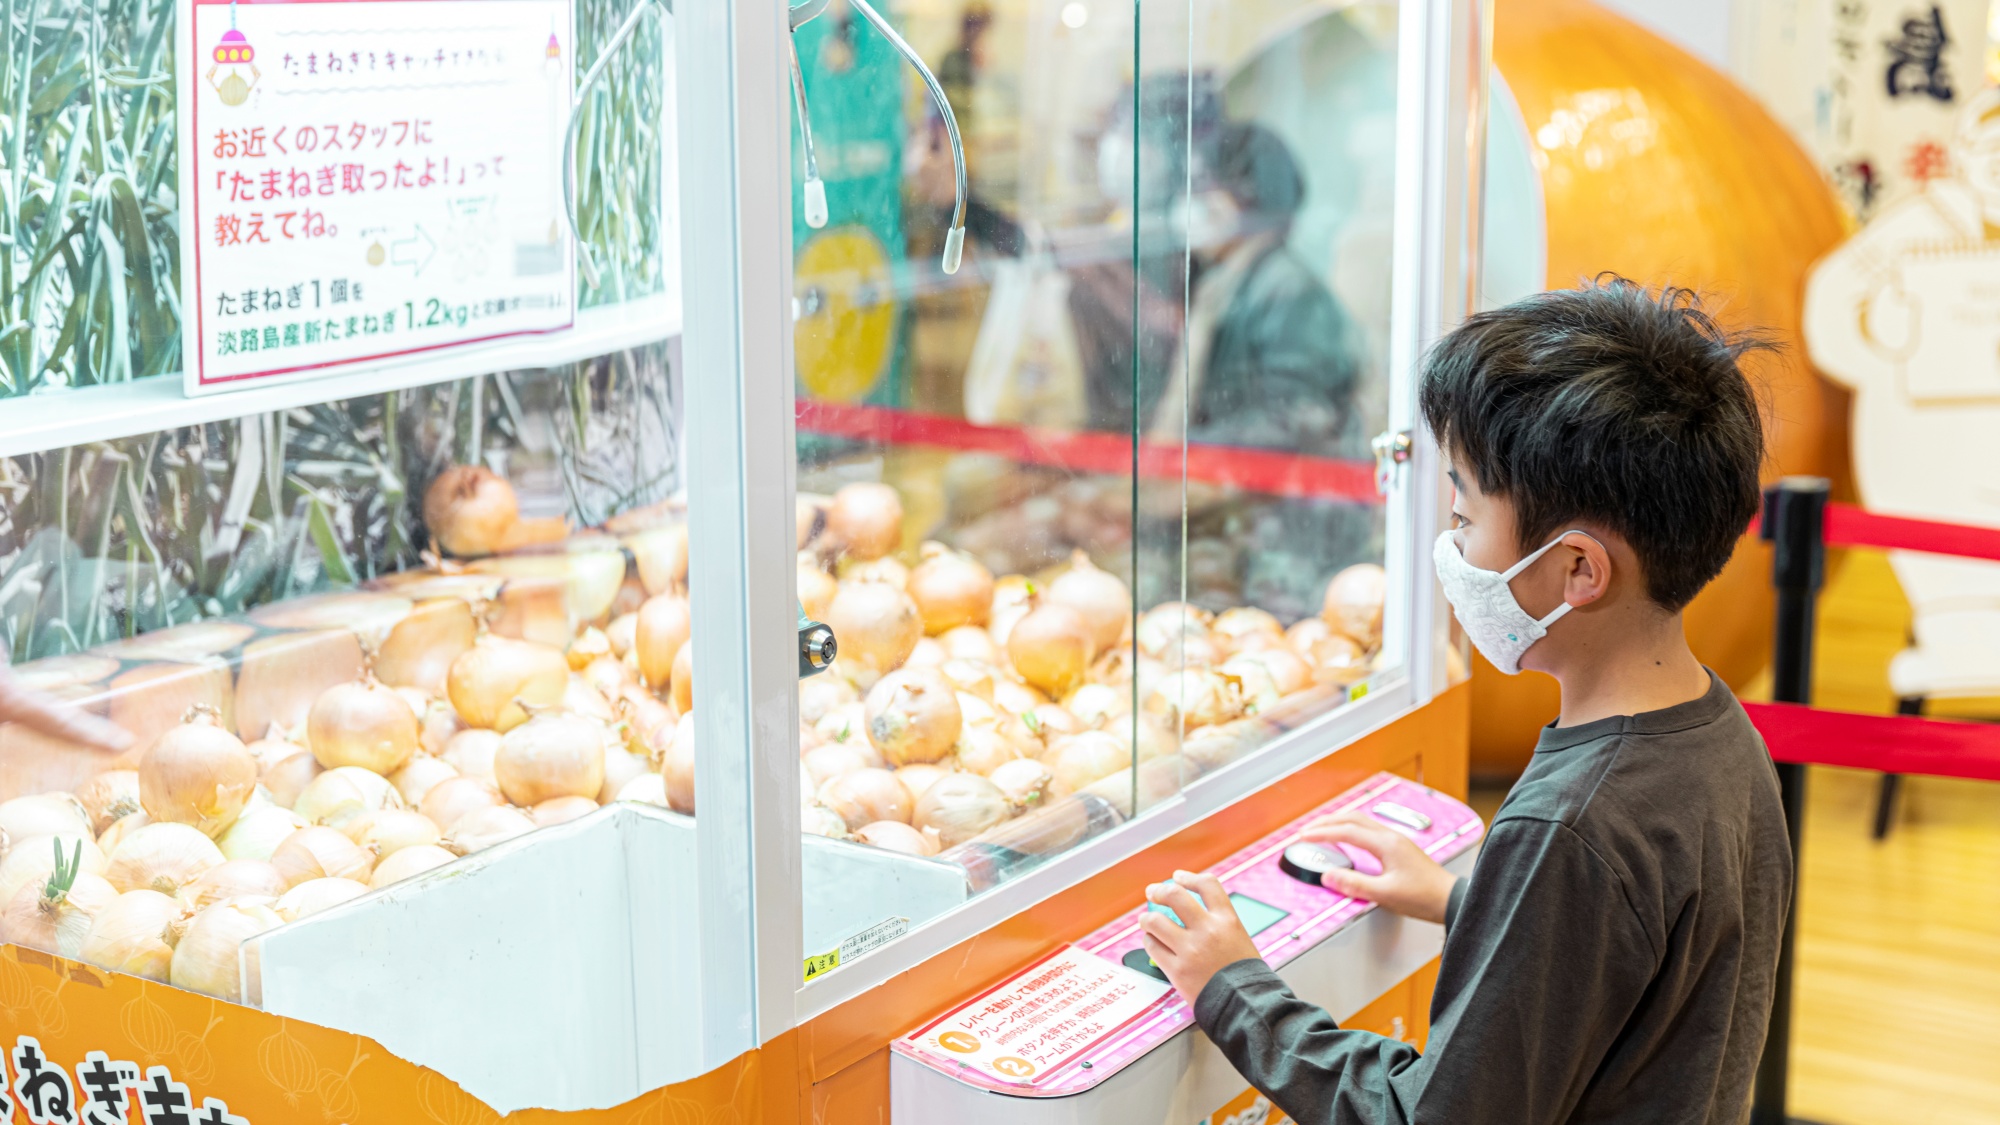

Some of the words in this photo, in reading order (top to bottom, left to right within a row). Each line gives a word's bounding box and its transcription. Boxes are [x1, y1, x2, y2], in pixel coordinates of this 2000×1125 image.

[213, 118, 434, 159] お近くのスタッフに
[214, 207, 339, 248] 教えてね。
